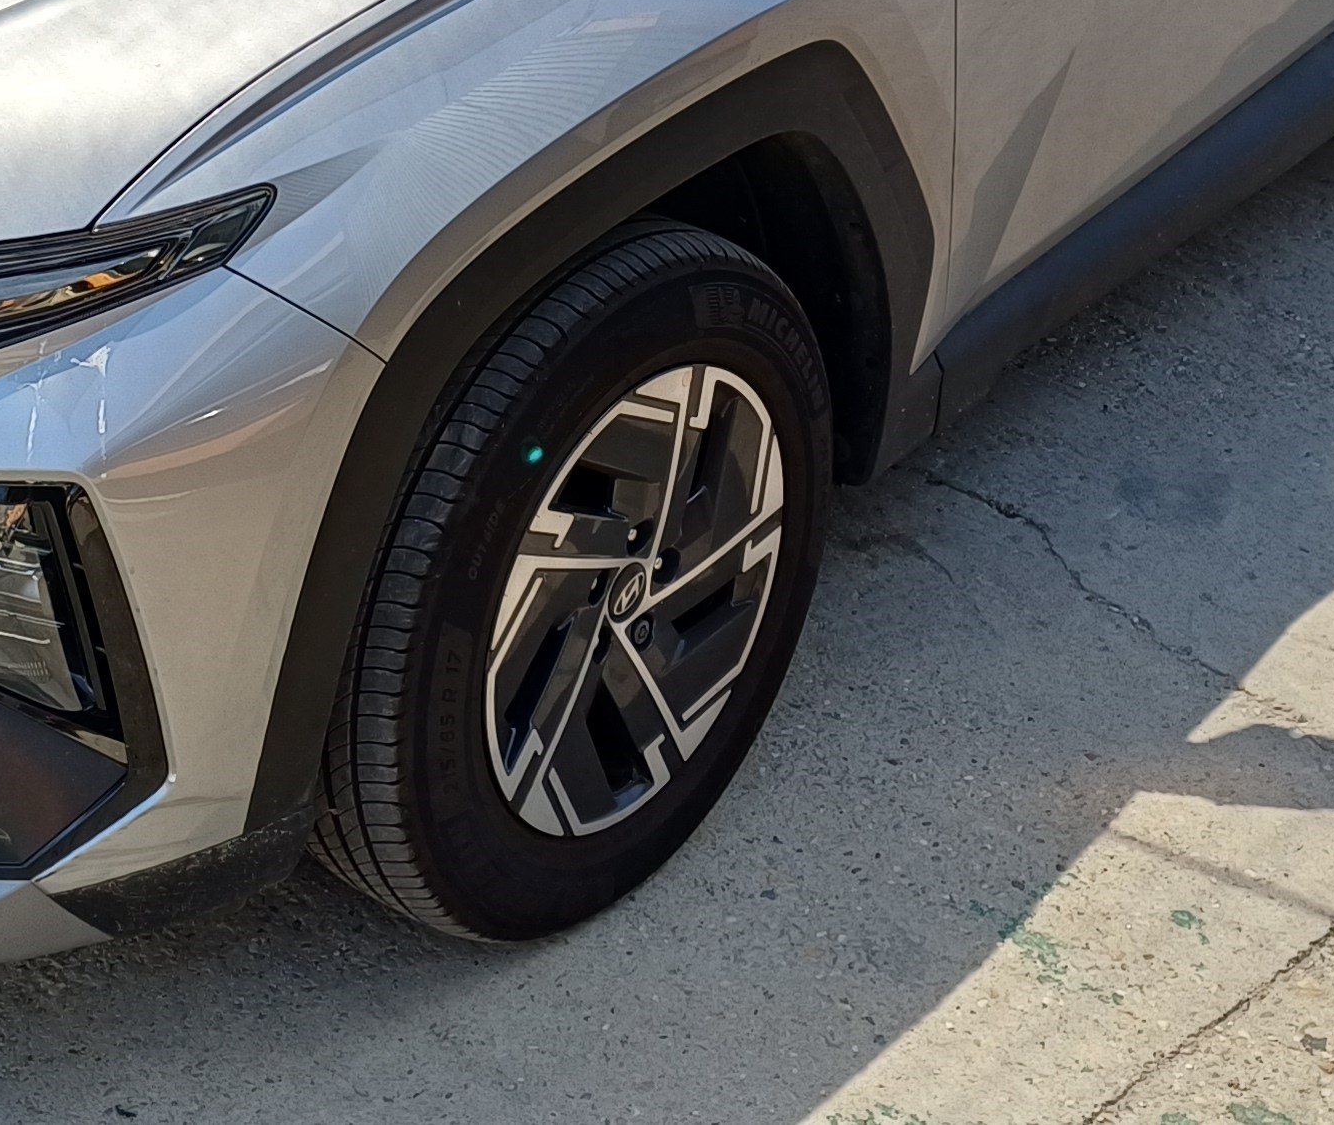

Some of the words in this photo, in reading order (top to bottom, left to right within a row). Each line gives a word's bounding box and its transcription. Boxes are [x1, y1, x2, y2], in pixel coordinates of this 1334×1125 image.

[746, 297, 826, 411] MICHELIN
[445, 650, 462, 674] 17
[442, 688, 458, 703] R
